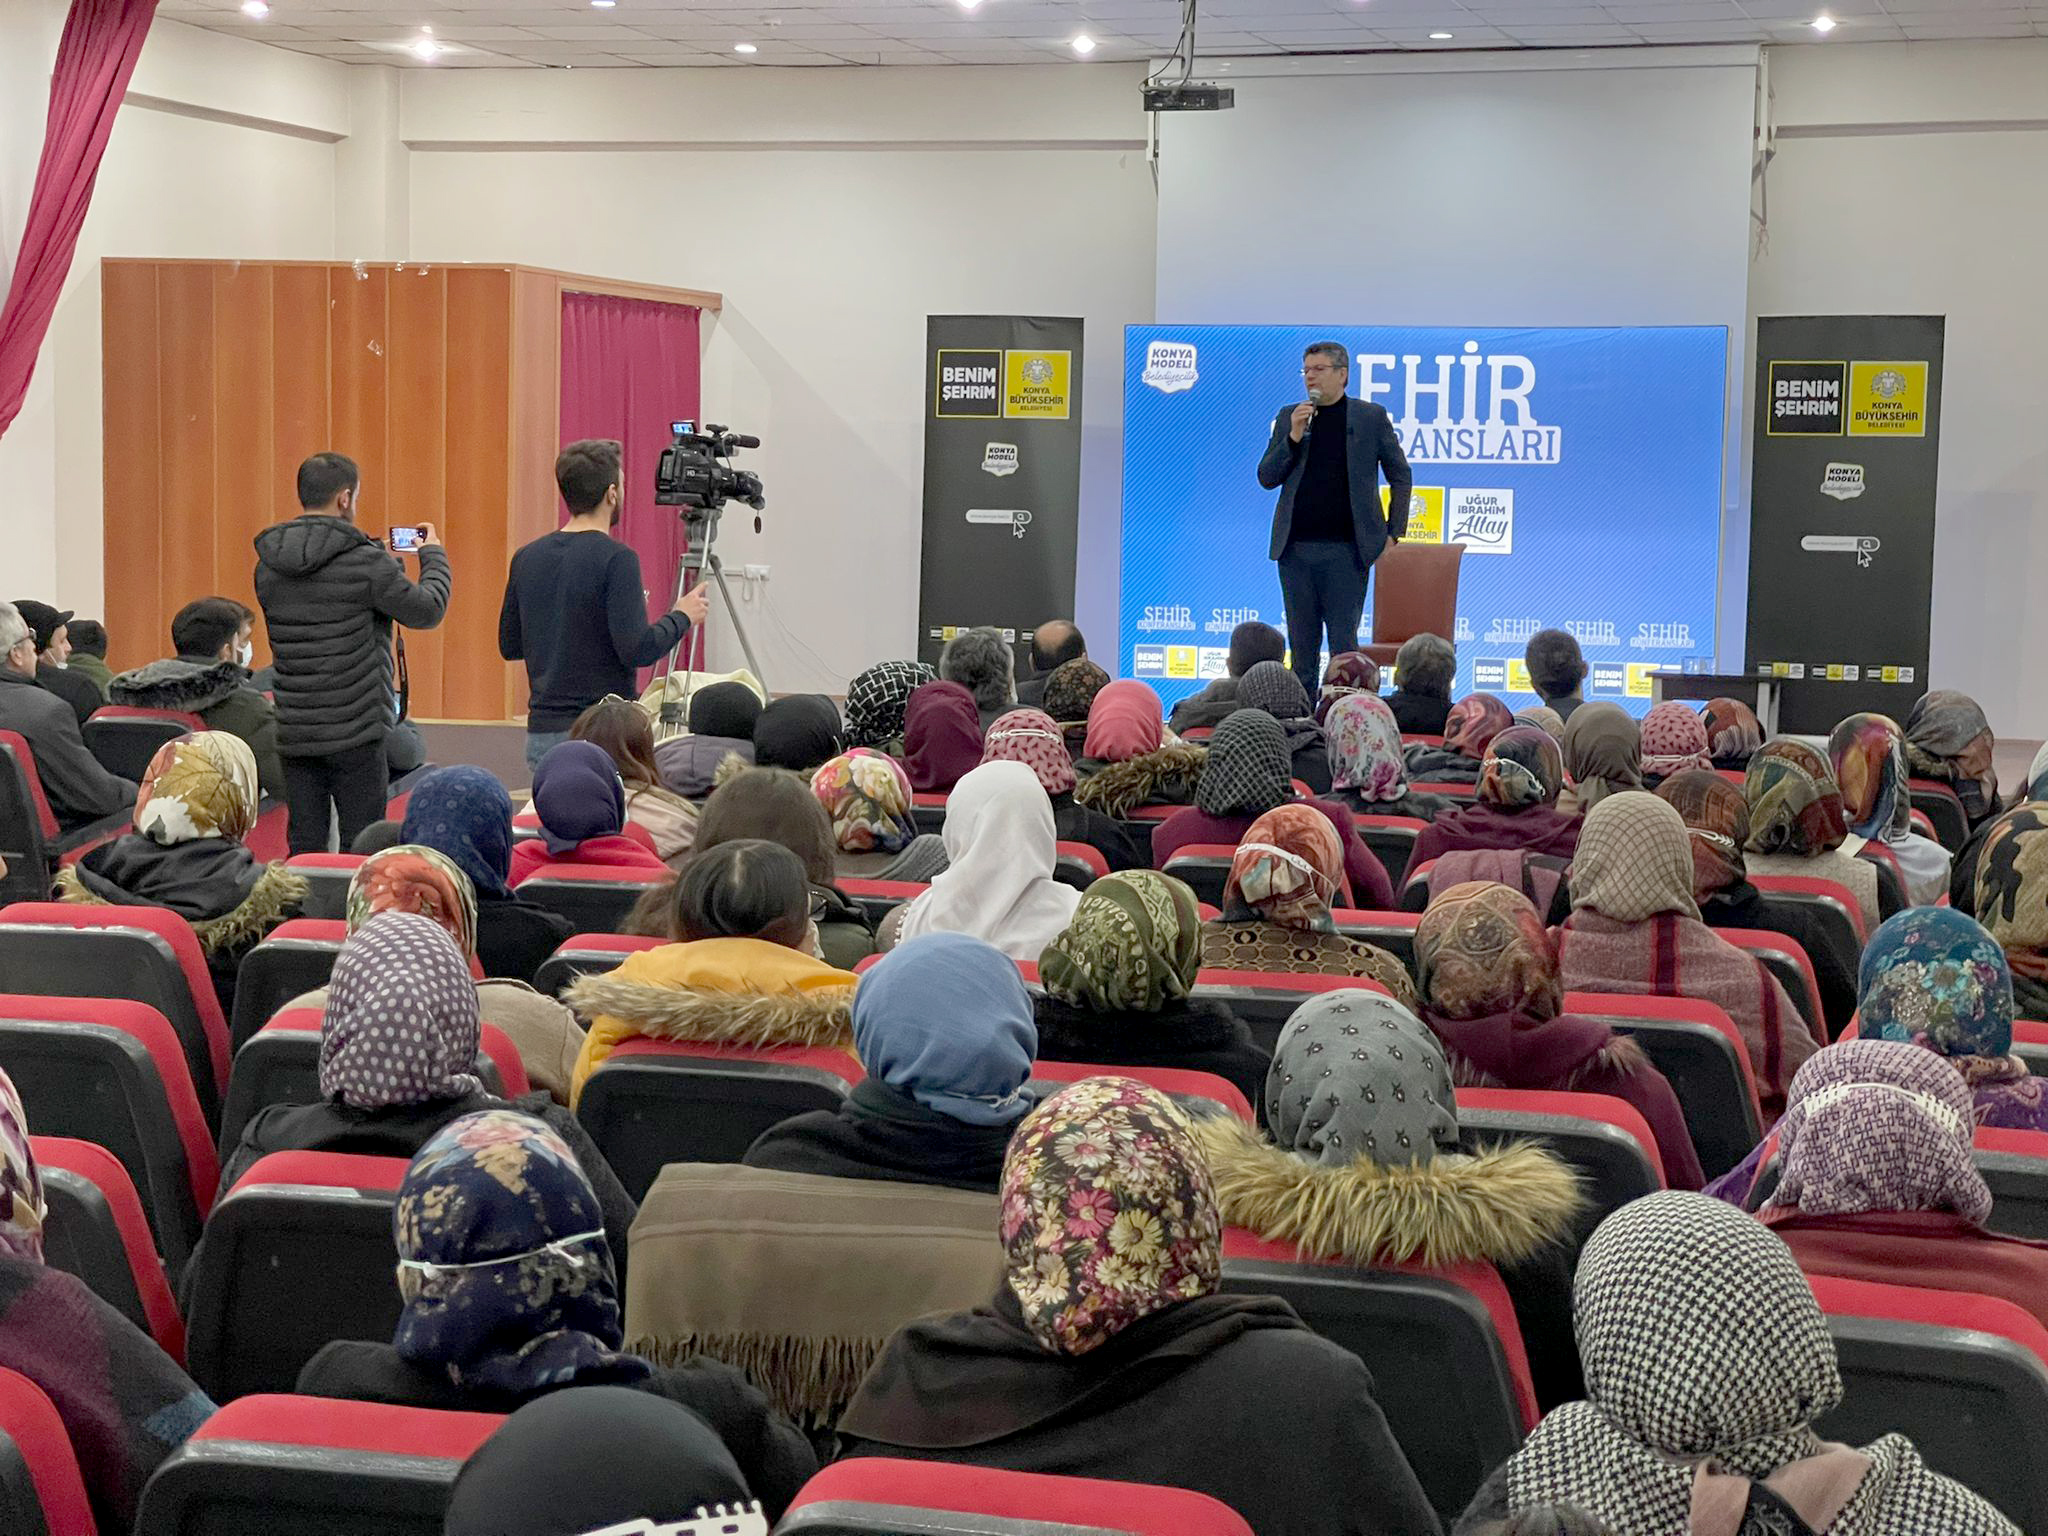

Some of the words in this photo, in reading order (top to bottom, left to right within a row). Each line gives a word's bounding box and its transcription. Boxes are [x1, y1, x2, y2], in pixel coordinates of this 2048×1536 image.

[1152, 348, 1193, 358] KONYA
[943, 367, 996, 383] BENİM
[1356, 340, 1538, 426] EHİR
[942, 385, 996, 401] ŞEHRİM
[1775, 380, 1839, 398] BENİM
[1774, 400, 1839, 418] ŞEHRİM
[1397, 428, 1555, 461] ANSLARI
[1466, 494, 1498, 505] UĞUR
[1452, 514, 1508, 543] Altay
